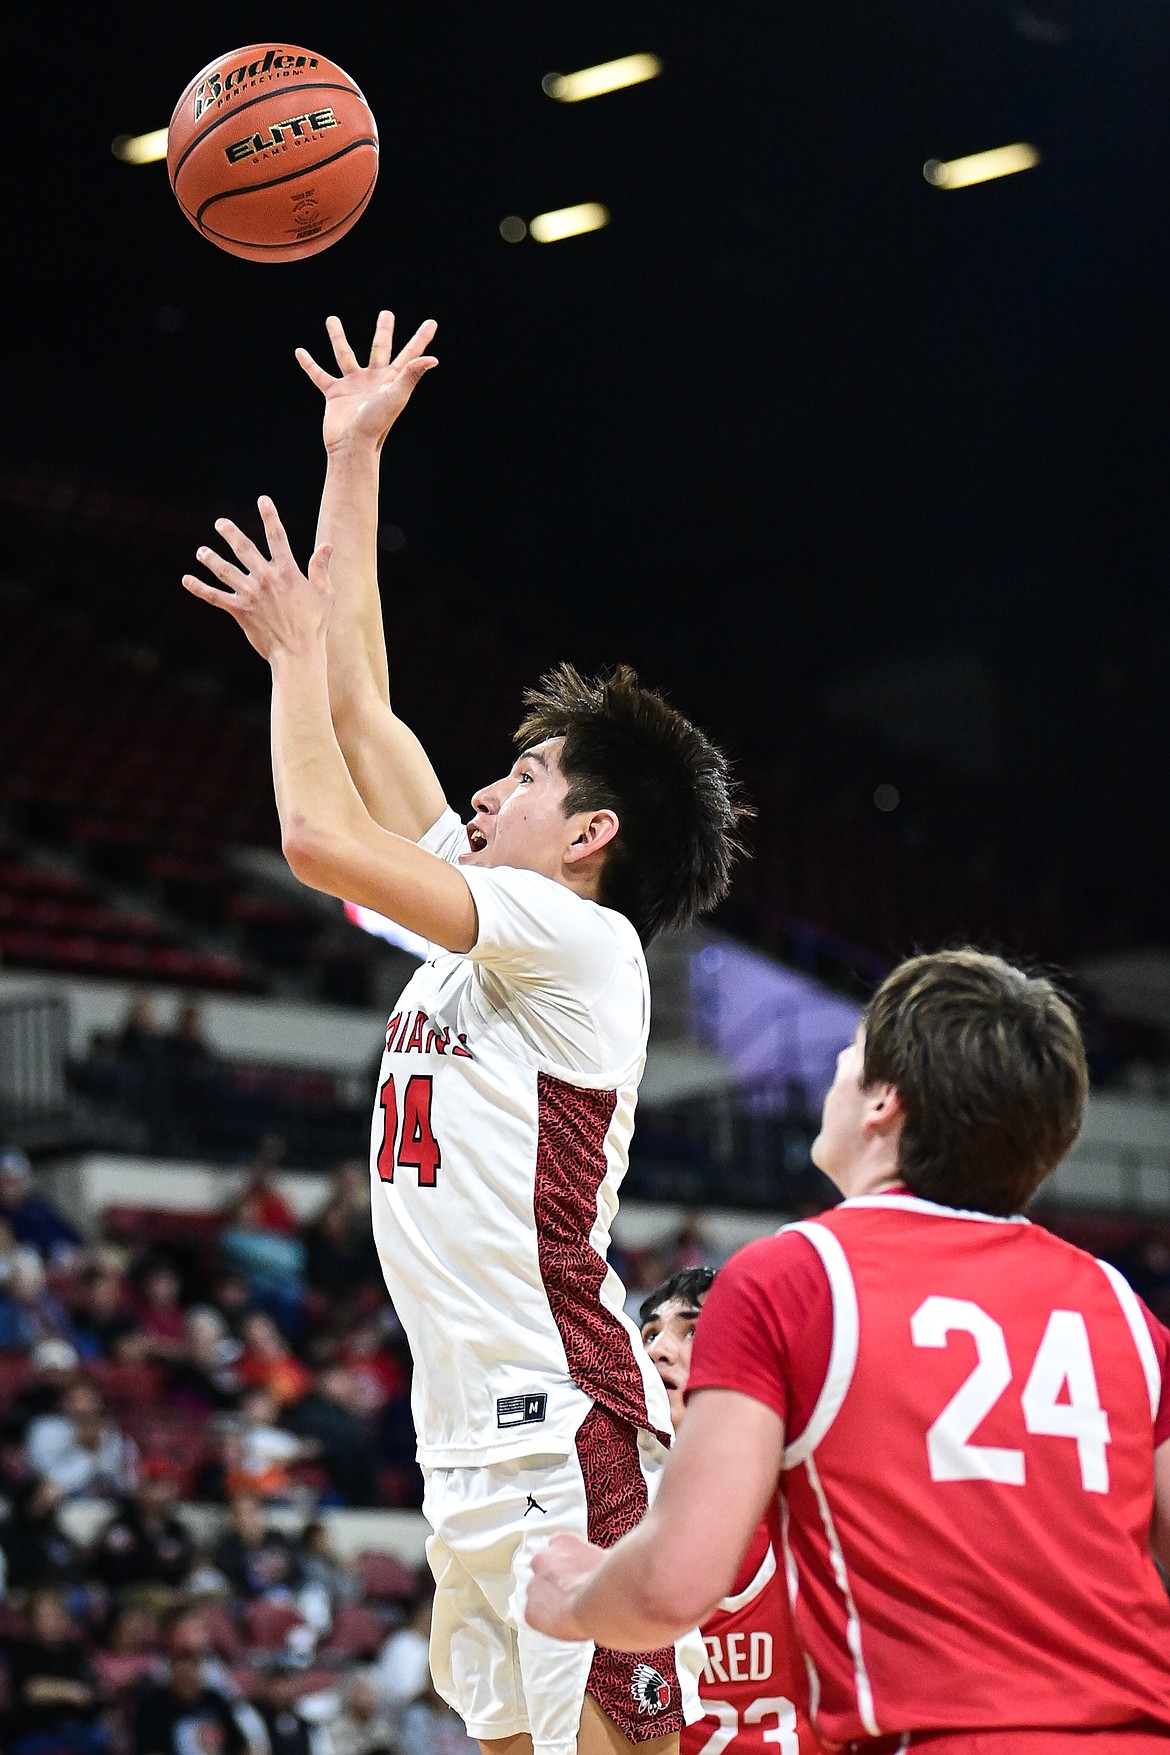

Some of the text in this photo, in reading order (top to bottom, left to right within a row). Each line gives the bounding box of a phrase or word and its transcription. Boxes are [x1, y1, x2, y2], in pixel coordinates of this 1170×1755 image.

[194, 49, 319, 124] Baden
[224, 106, 338, 166] ELITE
[252, 132, 325, 165] GAME BALL
[376, 1072, 442, 1188] 14
[909, 1295, 1112, 1495] 24
[701, 1631, 773, 1685] RED
